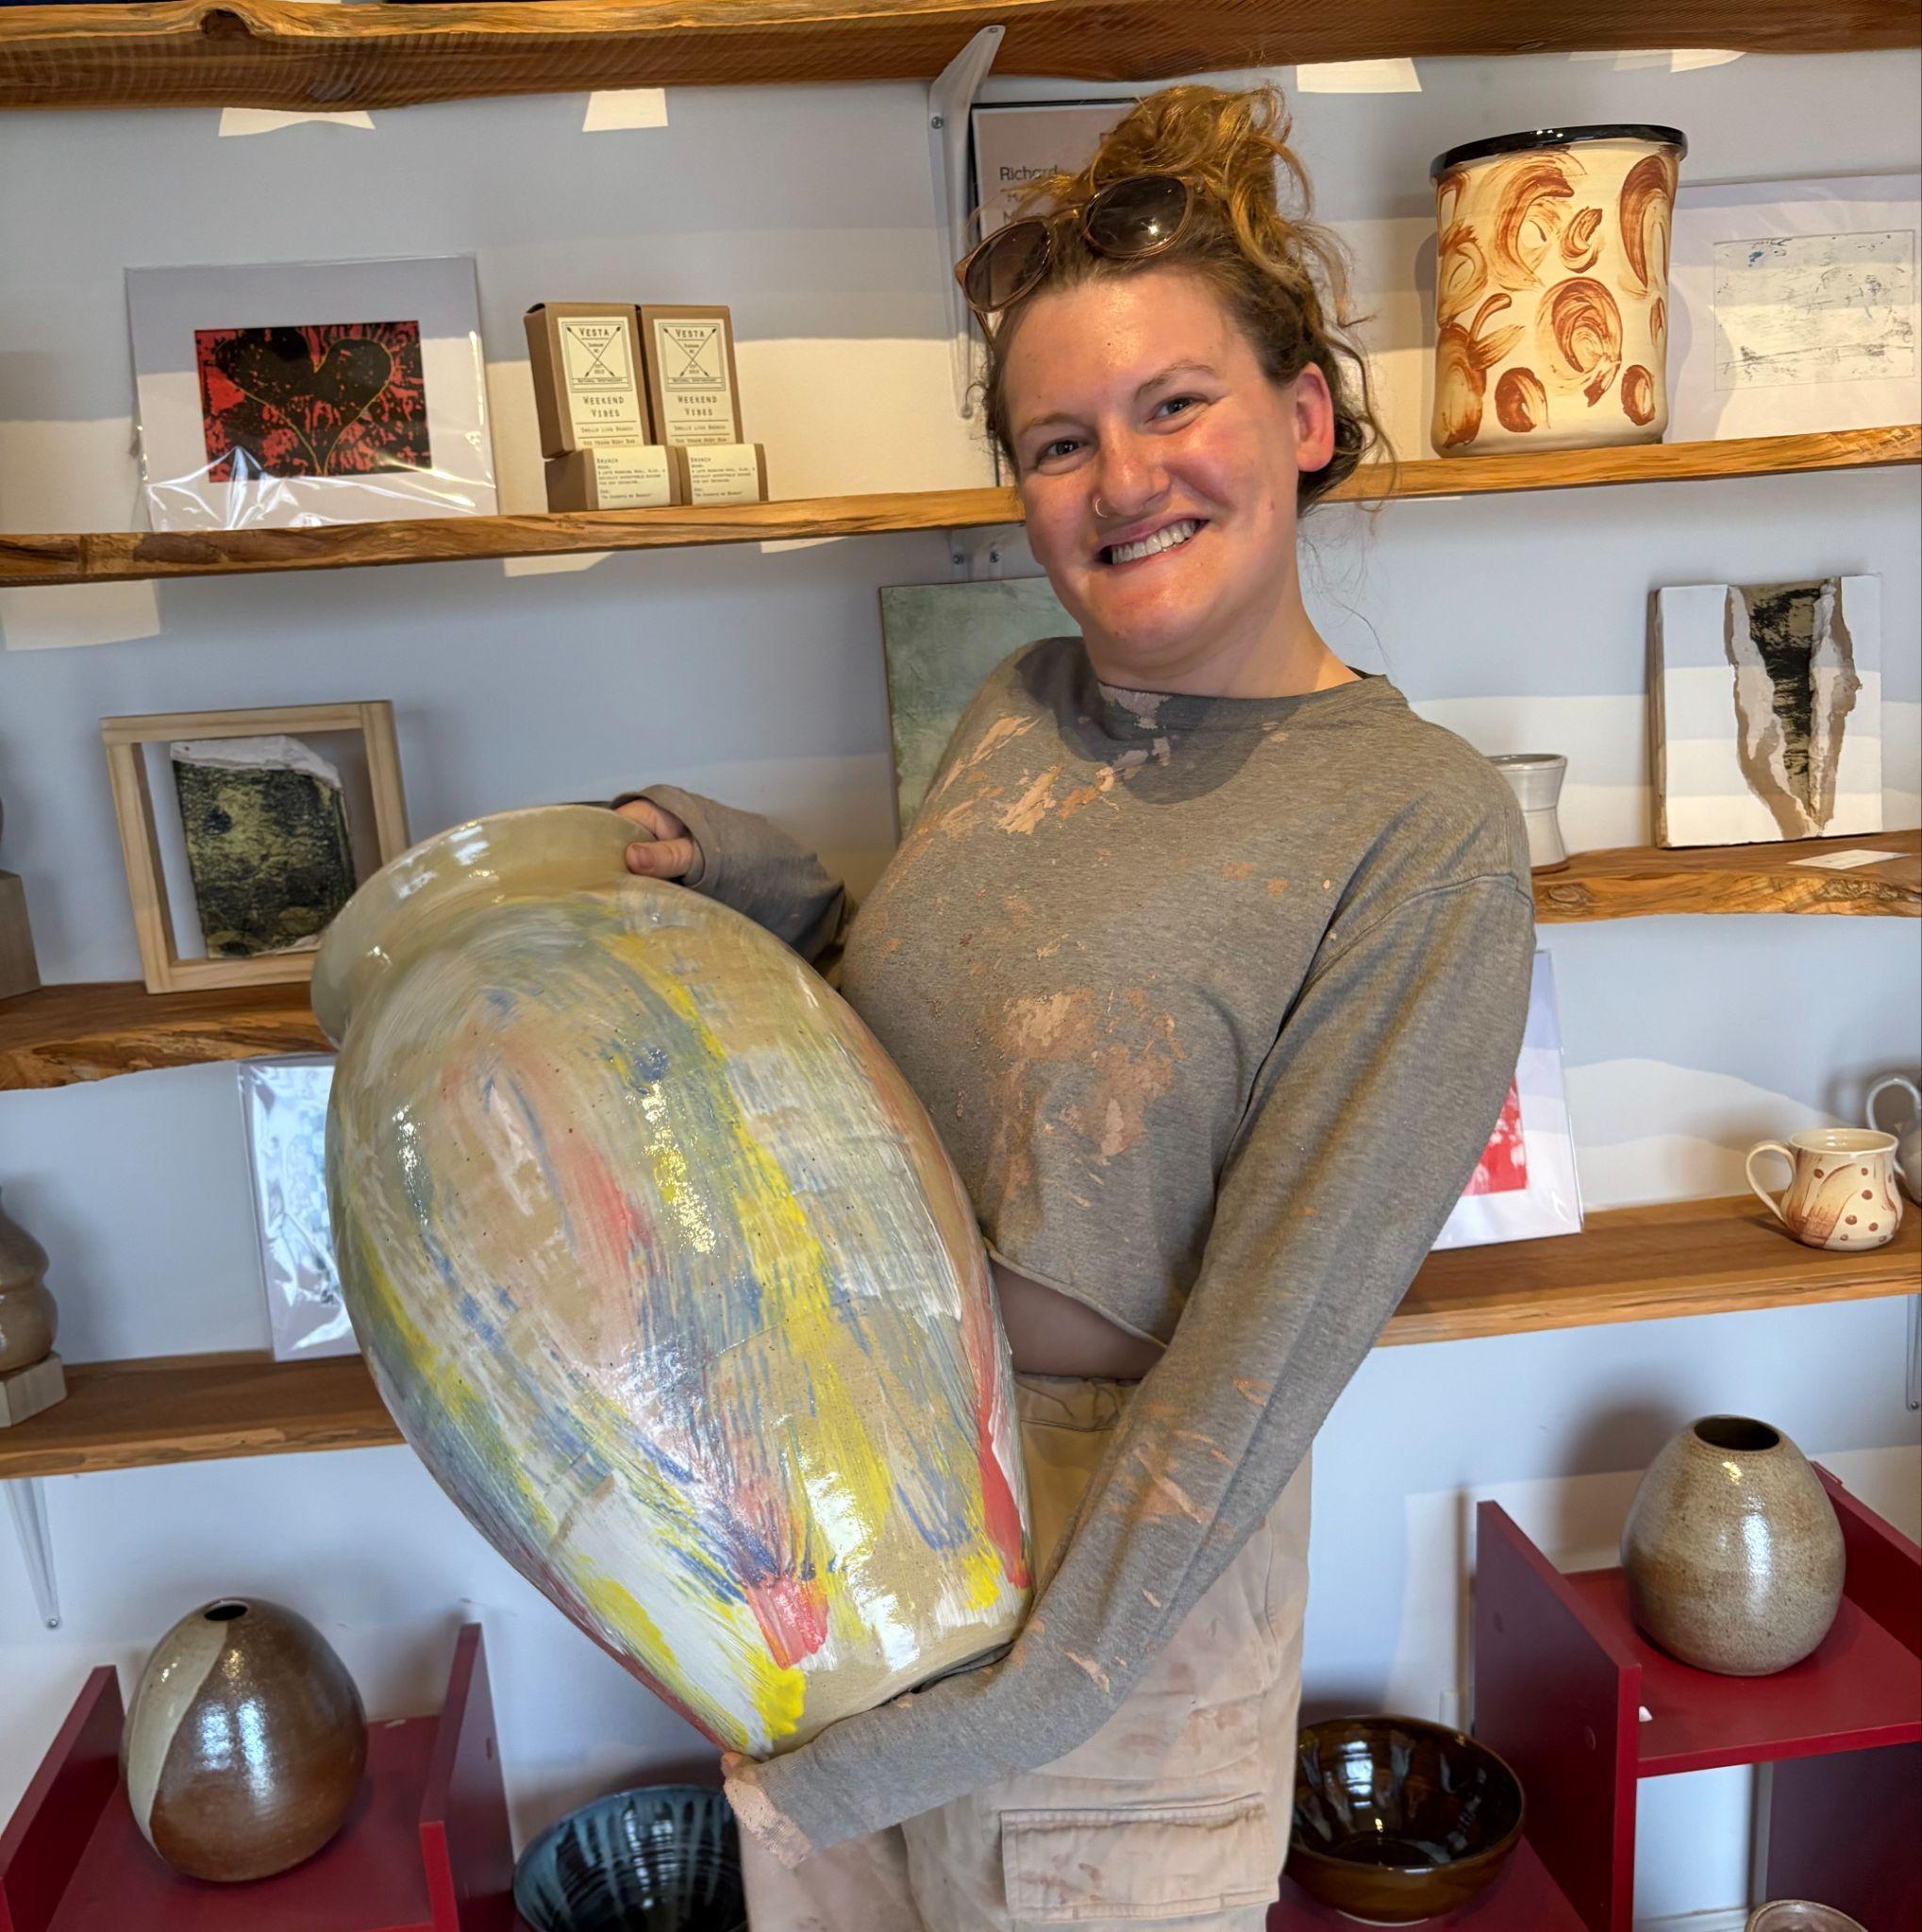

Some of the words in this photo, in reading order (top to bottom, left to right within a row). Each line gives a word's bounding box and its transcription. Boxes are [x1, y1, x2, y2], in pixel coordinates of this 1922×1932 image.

[578, 326, 610, 337] VESTA
[675, 328, 705, 338] VESTA
[582, 396, 625, 405] WEEKEND
[677, 395, 718, 404] WEEKEND
[591, 408, 620, 418] VIBES
[684, 408, 713, 416] VIBES
